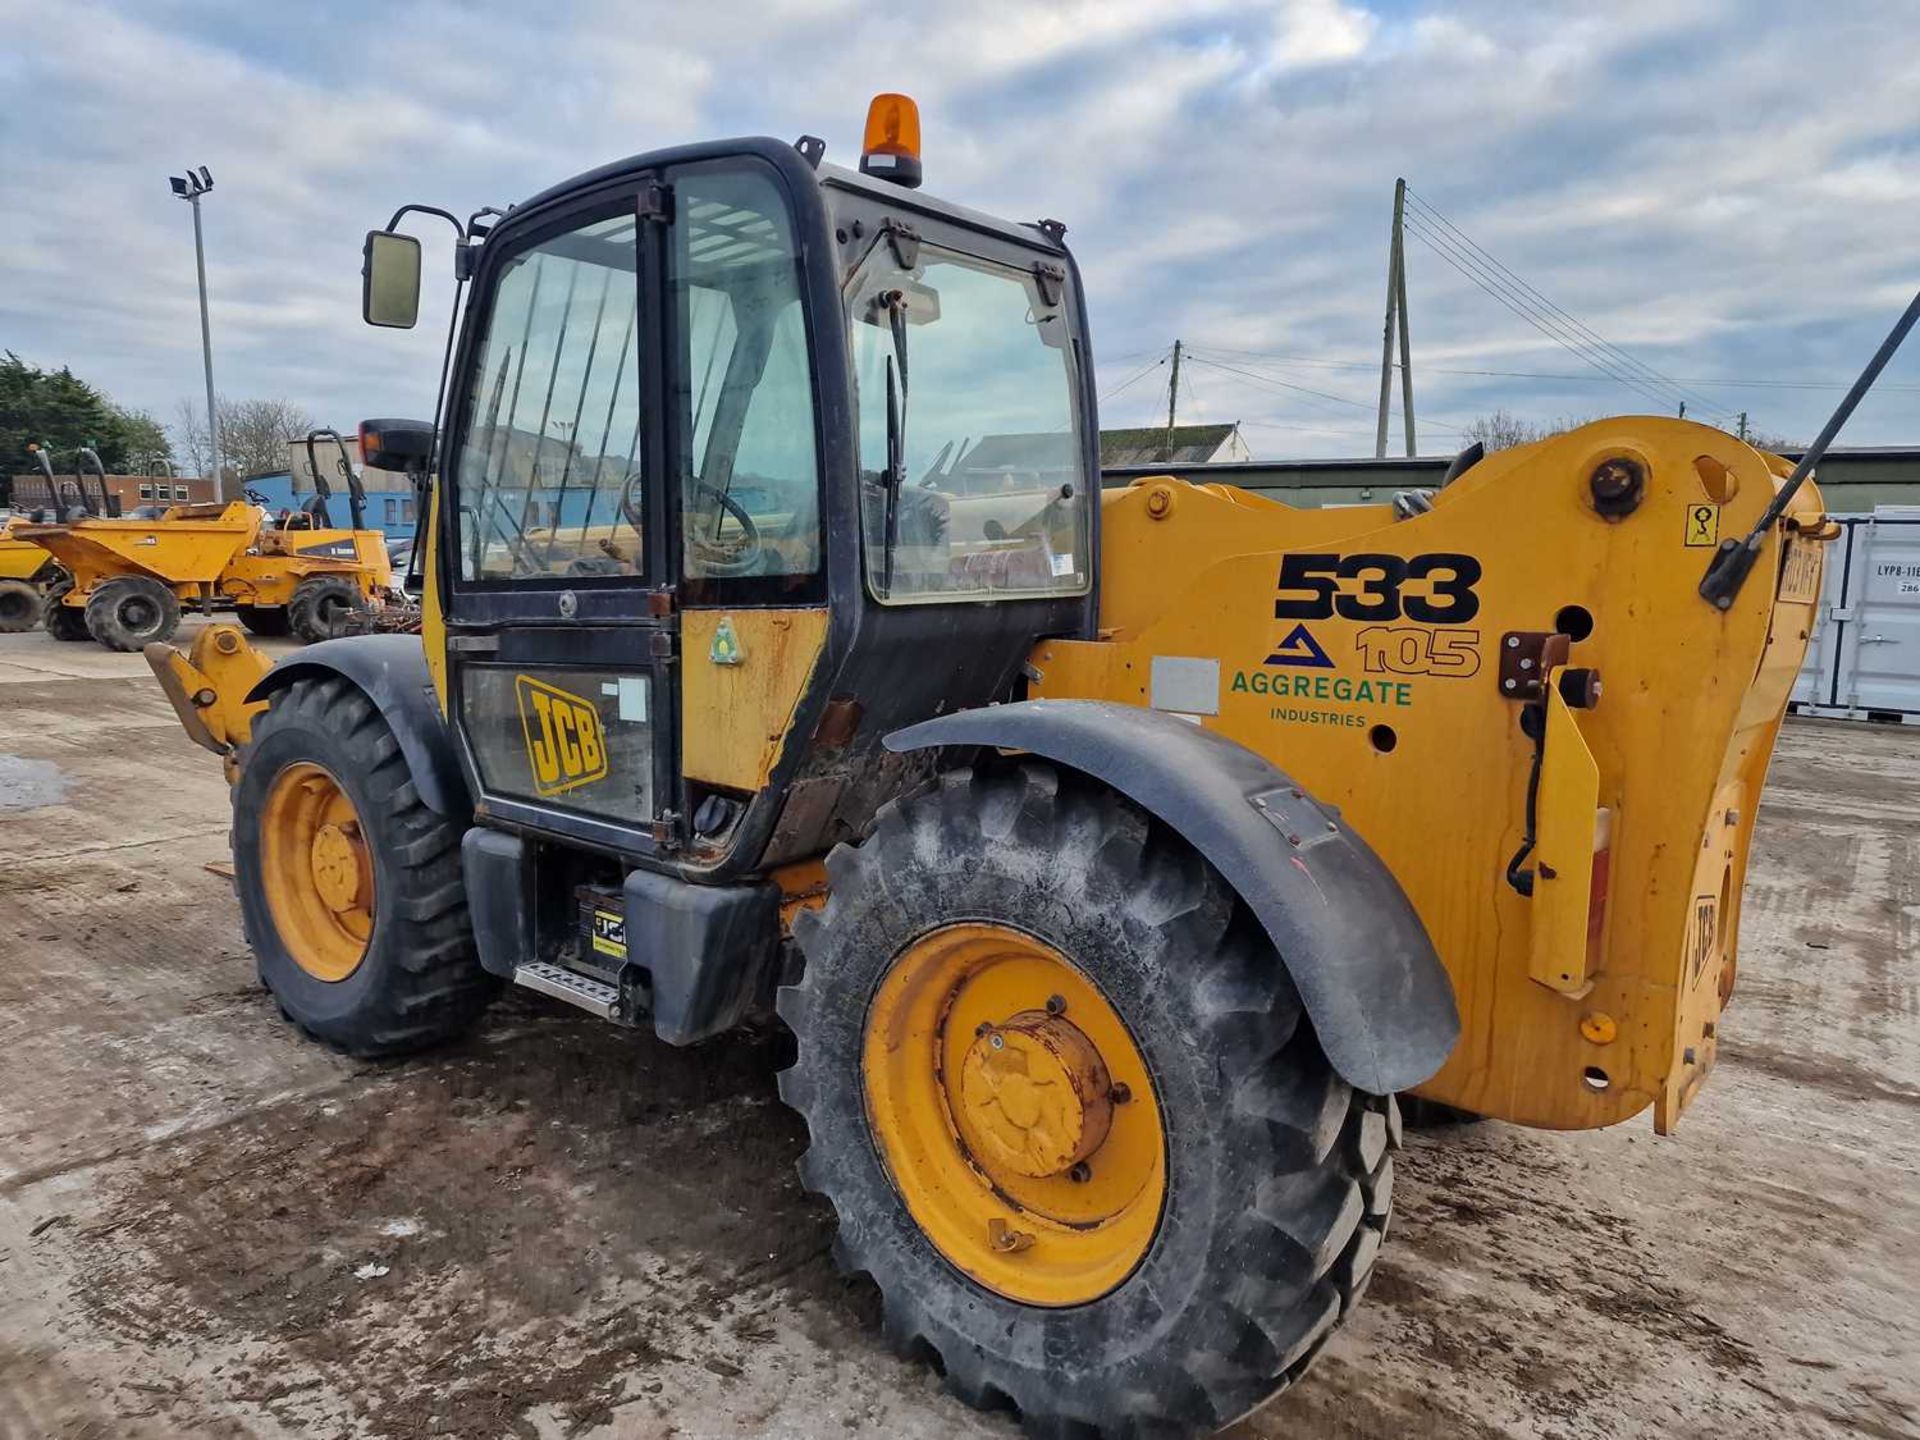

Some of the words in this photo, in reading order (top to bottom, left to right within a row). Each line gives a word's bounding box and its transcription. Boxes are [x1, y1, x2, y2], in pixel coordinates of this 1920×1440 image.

[1275, 553, 1482, 623] 533
[1356, 626, 1481, 678] 105
[1231, 671, 1412, 706] AGGREGATE
[531, 690, 601, 783] JCB
[1270, 707, 1366, 728] INDUSTRIES
